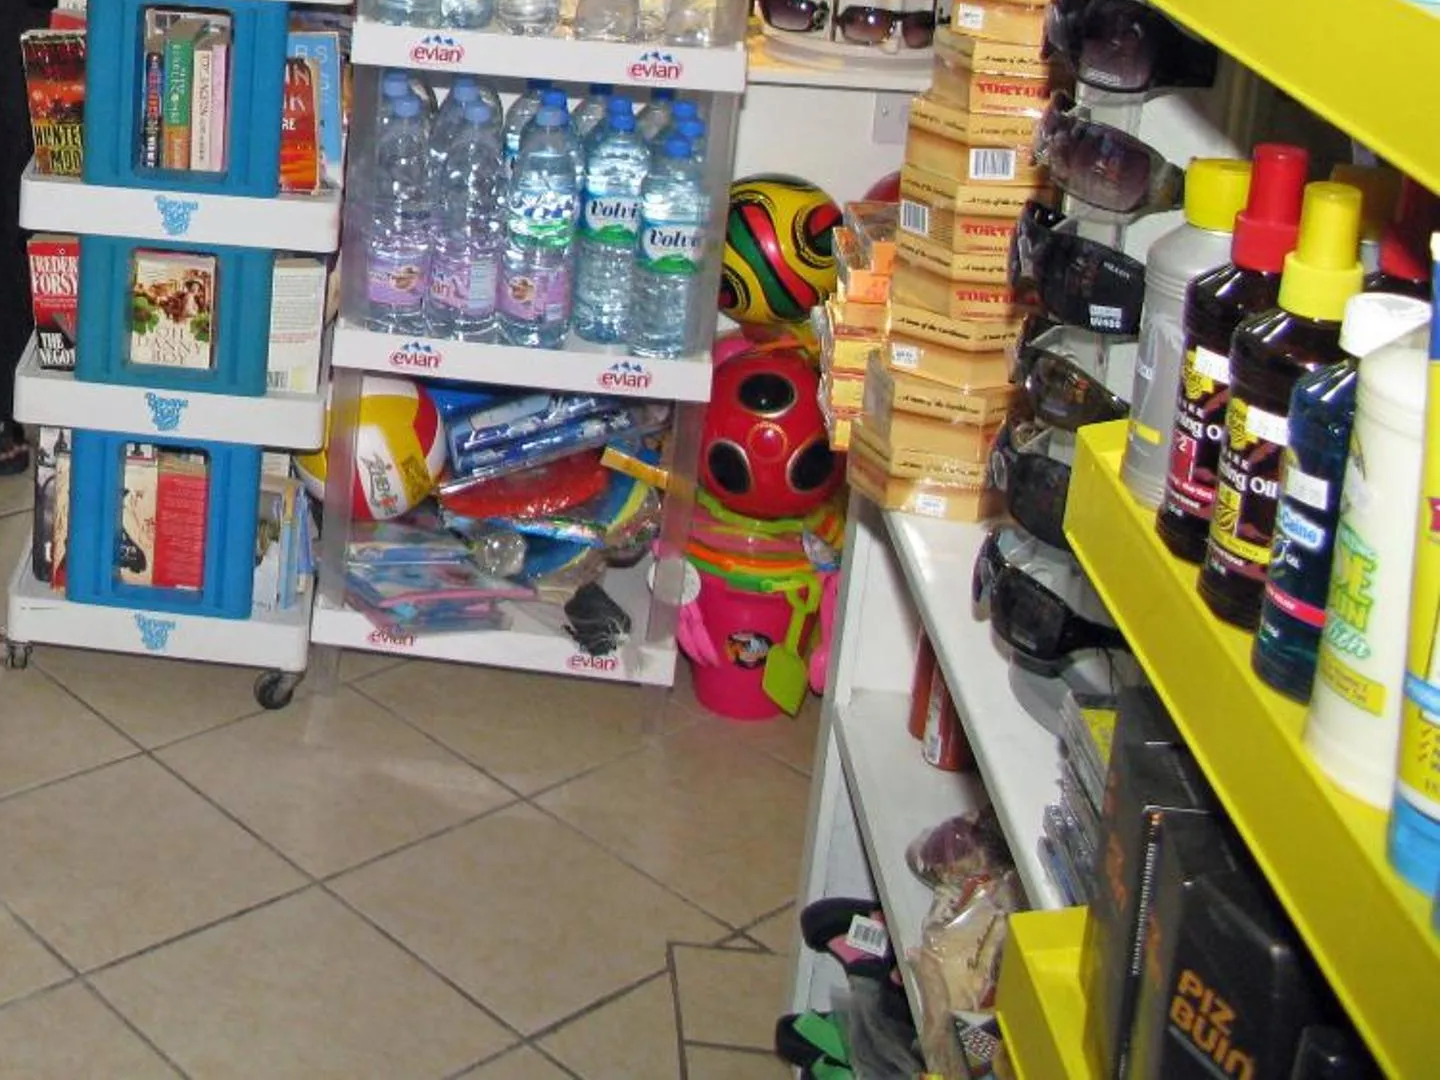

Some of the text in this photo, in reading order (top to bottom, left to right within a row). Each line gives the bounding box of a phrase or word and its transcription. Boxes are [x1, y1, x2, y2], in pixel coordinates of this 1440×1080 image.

[413, 42, 463, 65] evian
[631, 58, 681, 82] evian
[34, 124, 84, 146] HUNTE
[589, 198, 637, 219] Volvi
[31, 272, 79, 296] FORSY
[40, 332, 65, 349] THE
[392, 350, 442, 371] evian
[601, 370, 651, 391] evian
[1250, 476, 1278, 499] Oil
[568, 653, 618, 674] evian
[1177, 968, 1236, 1038] PIZ
